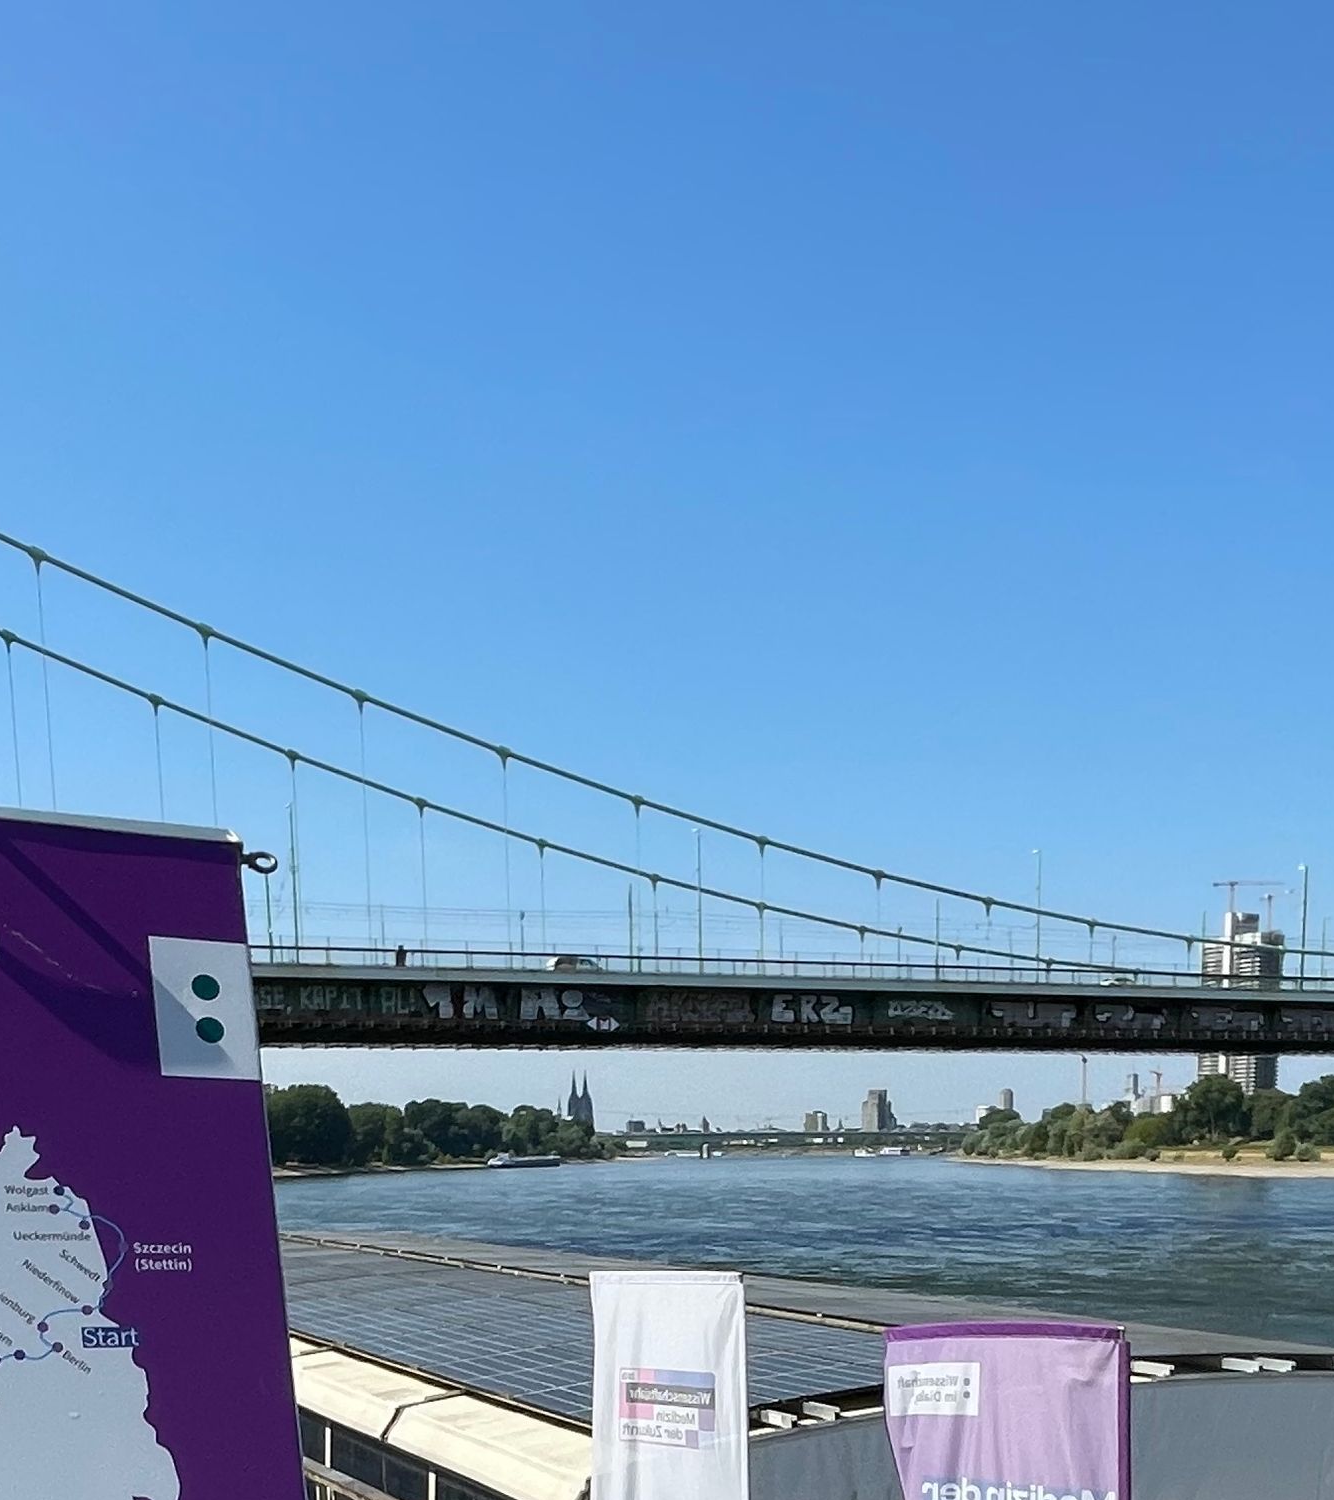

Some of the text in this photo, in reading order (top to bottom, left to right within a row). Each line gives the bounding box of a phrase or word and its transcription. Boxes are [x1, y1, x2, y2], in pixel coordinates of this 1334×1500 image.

[4, 1184, 49, 1198] Wolgast
[5, 1202, 51, 1214] Anklam
[13, 1231, 91, 1243] Ueckermünde
[133, 1241, 192, 1256] Szczecin
[58, 1248, 101, 1283] Schwedt
[134, 1258, 193, 1273] (Stettin)
[21, 1258, 80, 1305] Niederfinow
[83, 1327, 140, 1347] Start
[61, 1350, 93, 1376] Berlin
